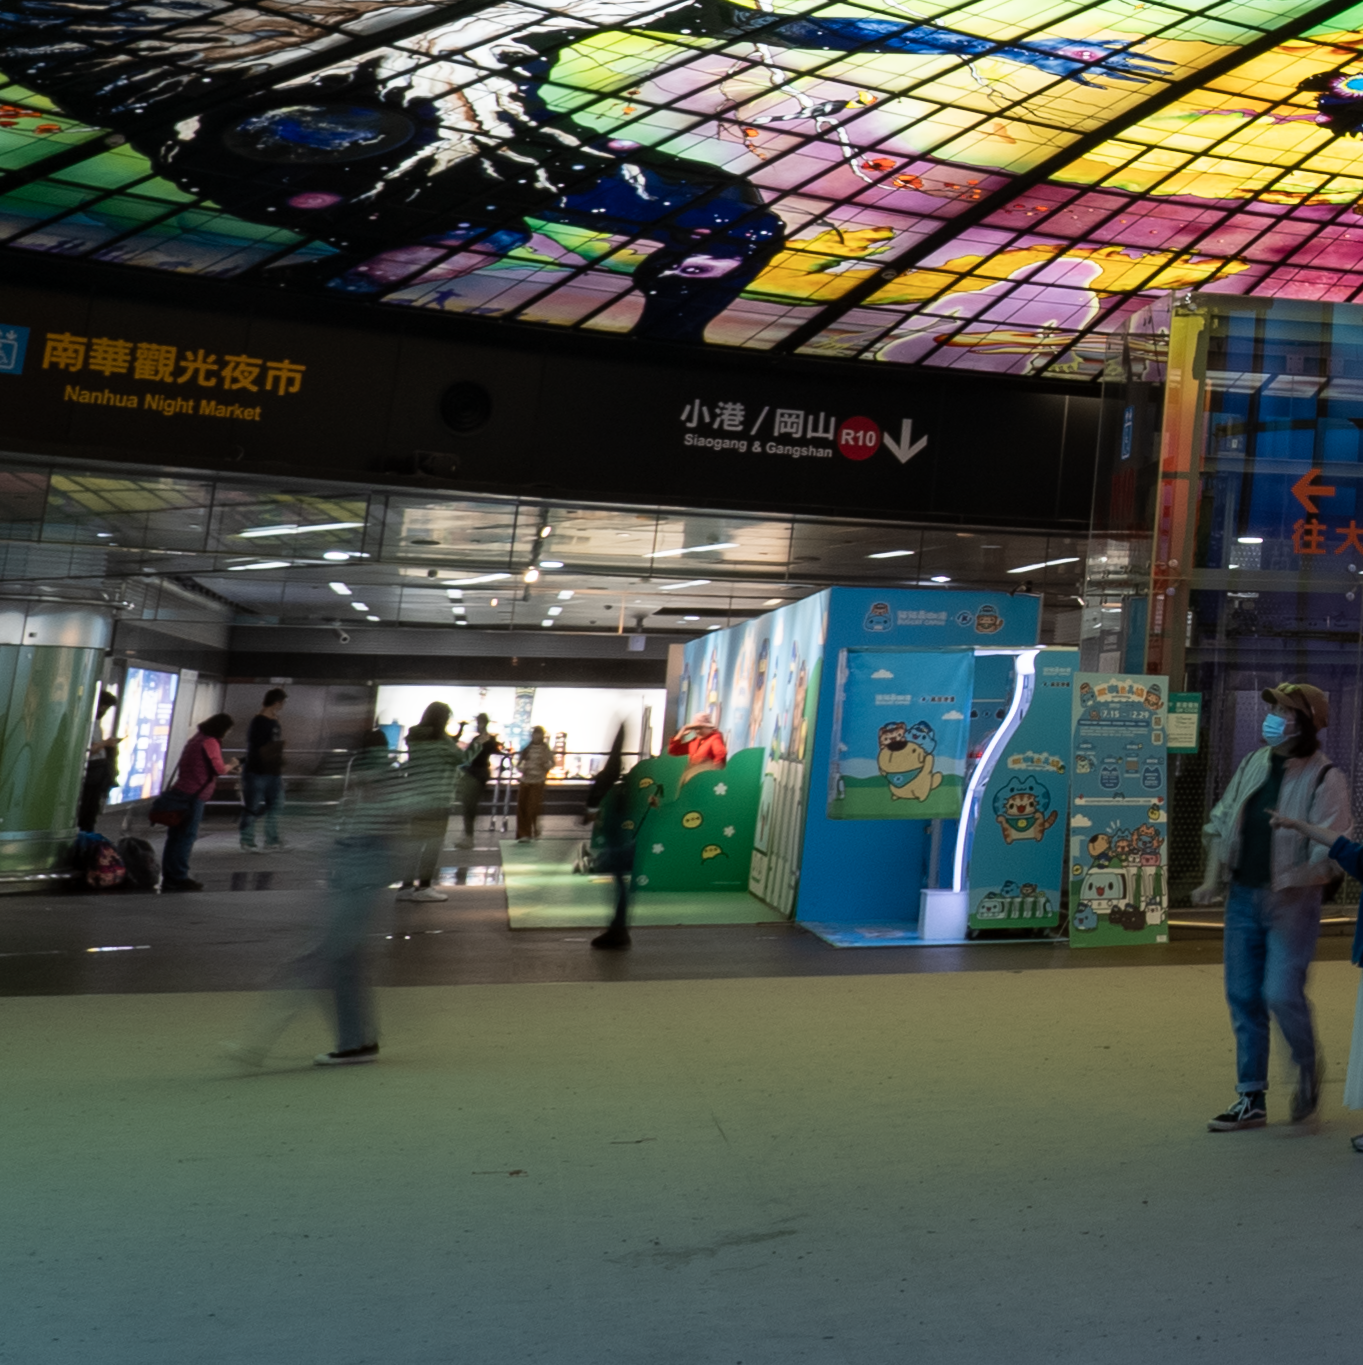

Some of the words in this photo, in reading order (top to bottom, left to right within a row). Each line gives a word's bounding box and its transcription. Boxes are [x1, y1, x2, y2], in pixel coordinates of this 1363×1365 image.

[42, 332, 307, 396] 南華觀光夜市
[64, 384, 138, 409] Nanhua
[143, 393, 195, 416] Night
[199, 399, 262, 421] Market
[684, 432, 747, 453] Siaogang
[752, 443, 763, 453] &
[766, 442, 833, 458] Gangshan
[840, 430, 876, 447] R10
